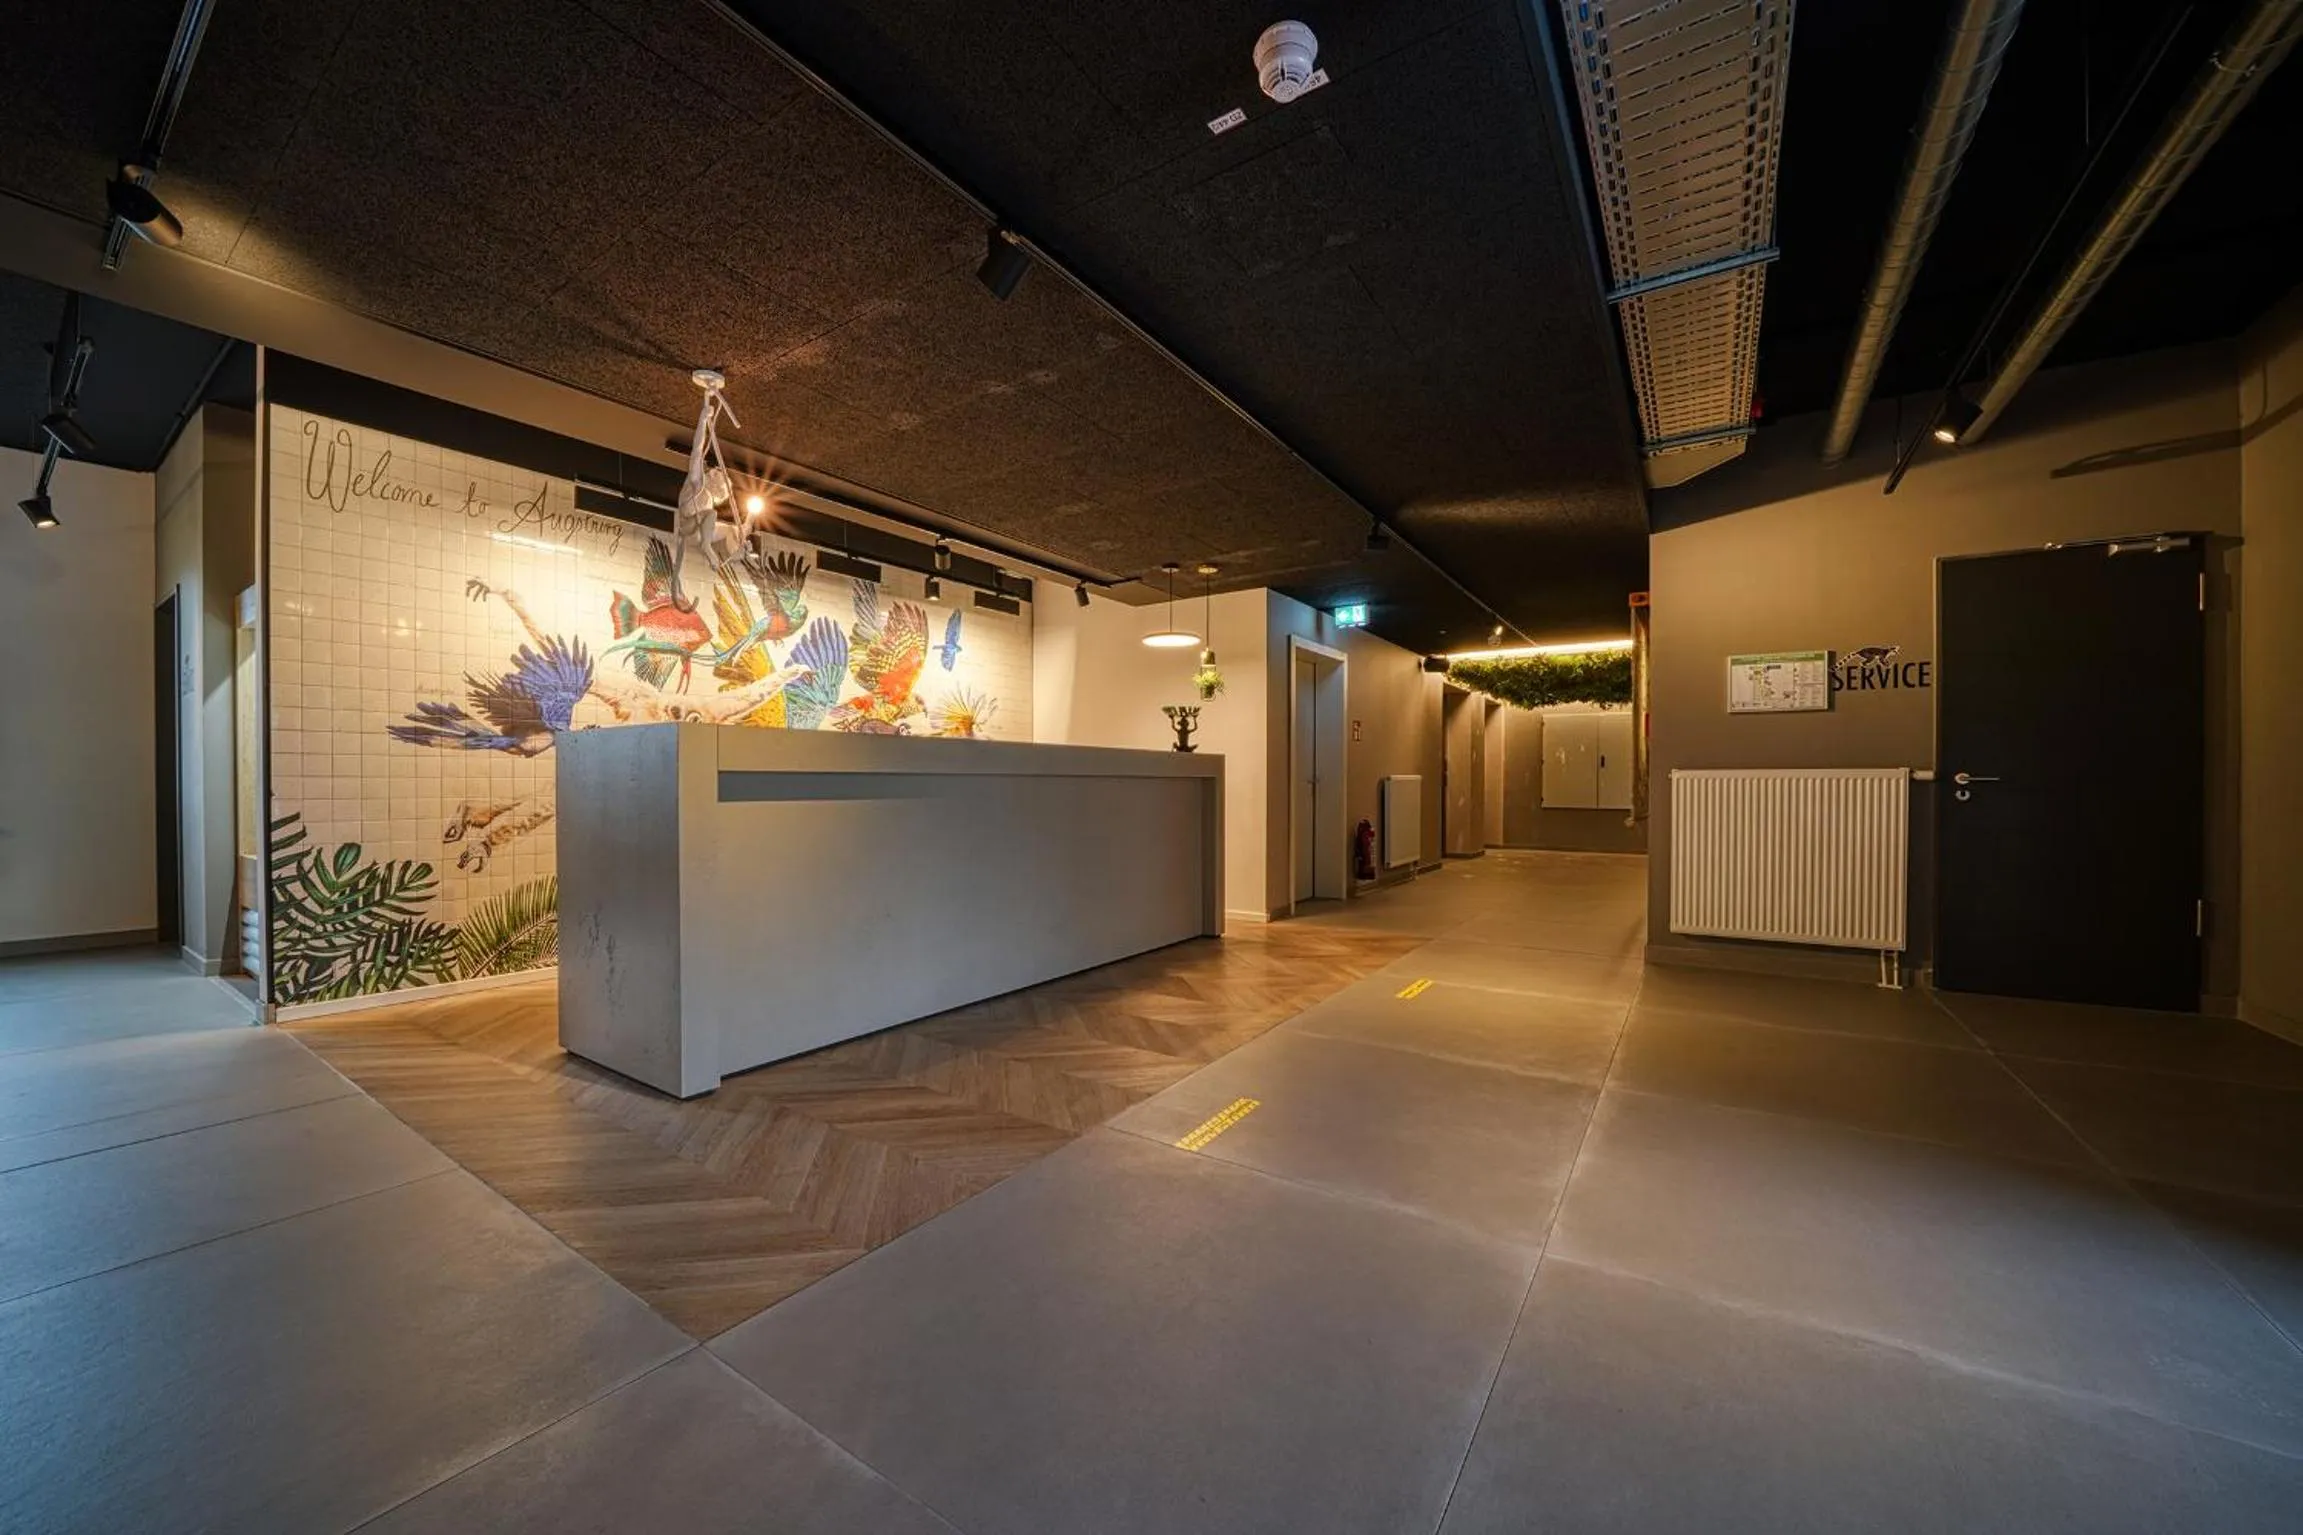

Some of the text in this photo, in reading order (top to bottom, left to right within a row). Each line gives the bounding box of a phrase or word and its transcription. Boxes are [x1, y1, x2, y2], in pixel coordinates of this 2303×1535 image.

[304, 420, 624, 556] Welcome to Augsburg
[1832, 662, 1931, 691] SERVICE
